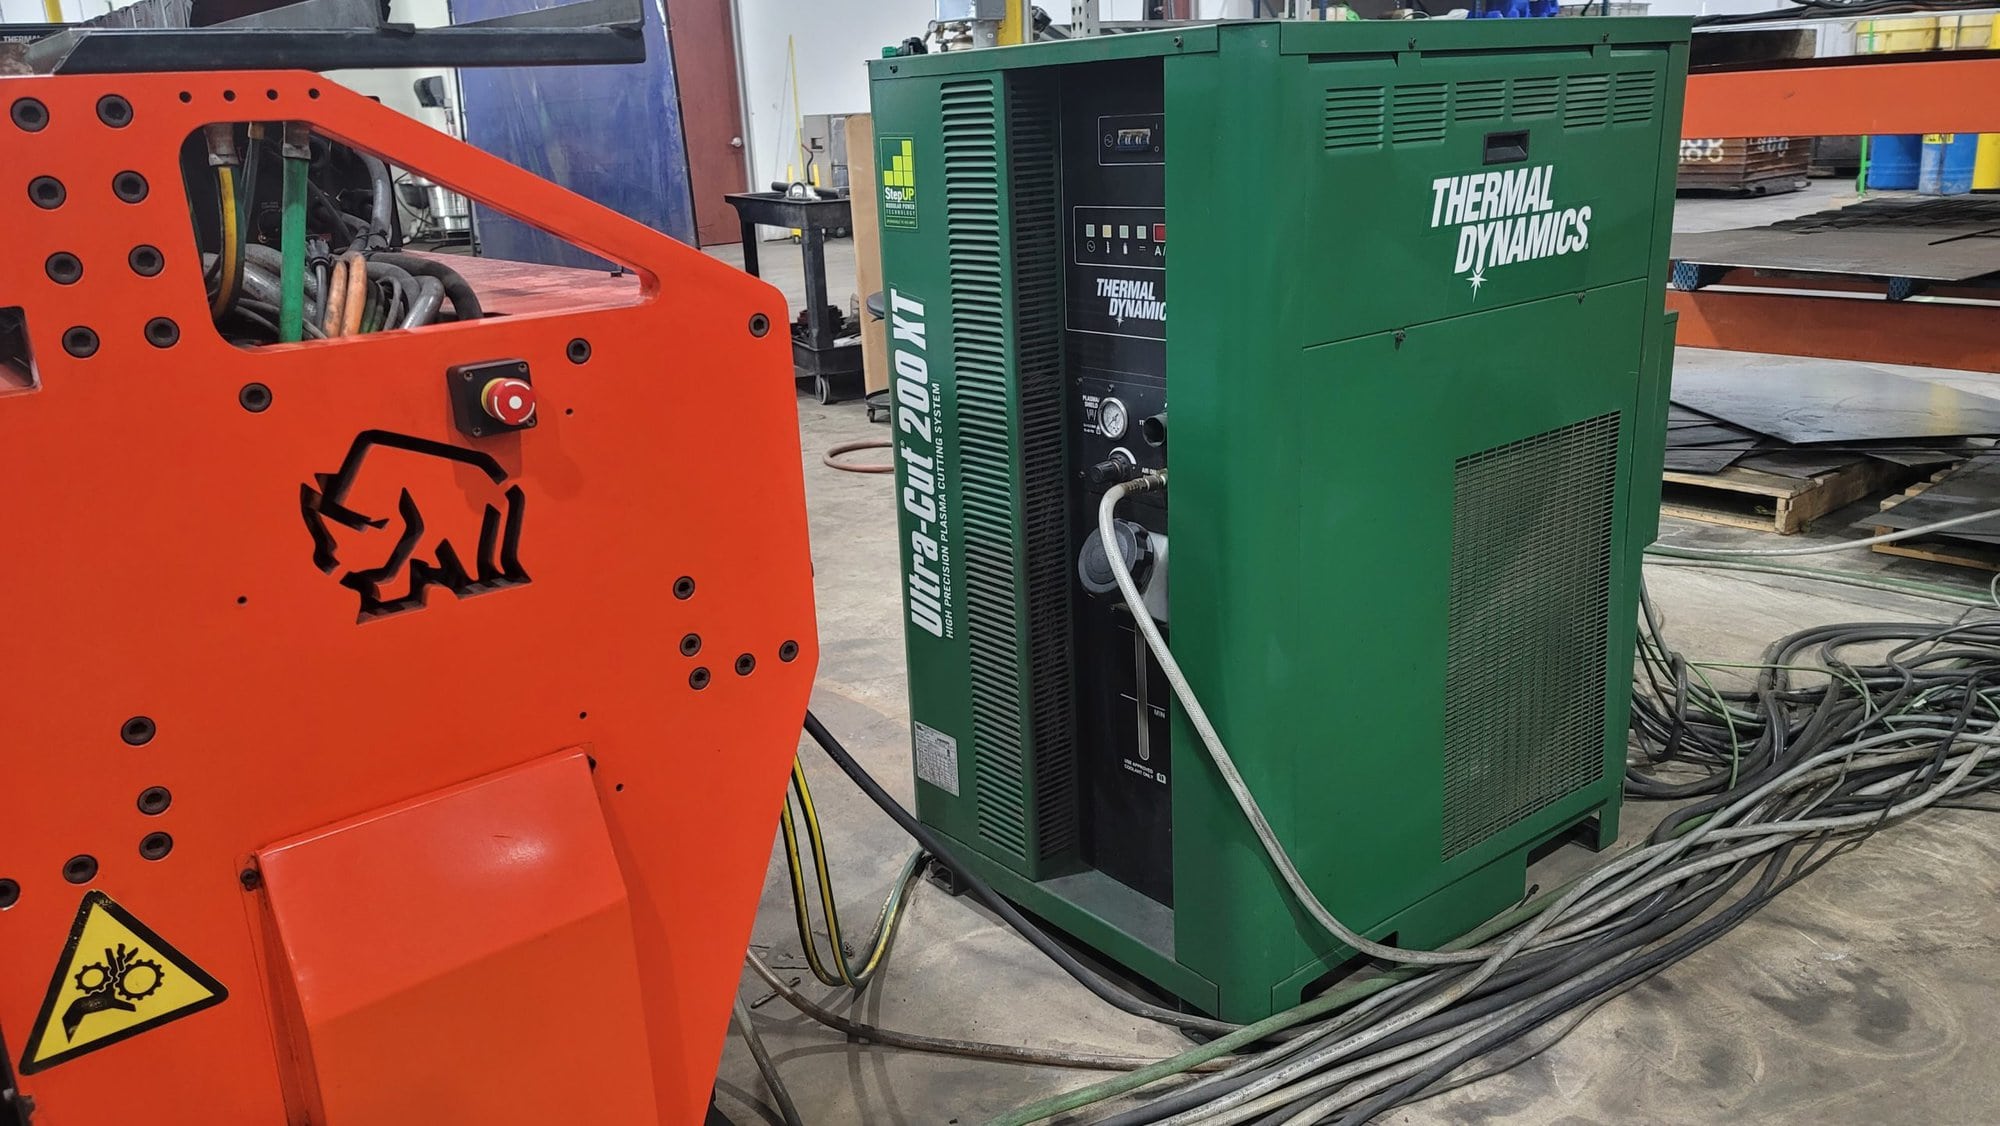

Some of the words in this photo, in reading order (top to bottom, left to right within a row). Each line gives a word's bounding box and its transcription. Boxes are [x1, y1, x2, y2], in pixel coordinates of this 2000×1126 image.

[884, 187, 914, 202] StepUP
[1431, 165, 1553, 228] THERMAL
[1454, 205, 1592, 274] DYNAMICS
[1096, 278, 1155, 300] THERMAL
[890, 288, 926, 350] XT
[895, 349, 933, 443] 200
[931, 383, 943, 433] SYSTEM
[935, 438, 946, 490] CUTTING
[901, 445, 943, 638] Ultra-Cut
[938, 493, 949, 542] PLASMA
[942, 546, 953, 607] PRECISION
[945, 611, 954, 639] HIGH
[1153, 707, 1166, 720] MIN
